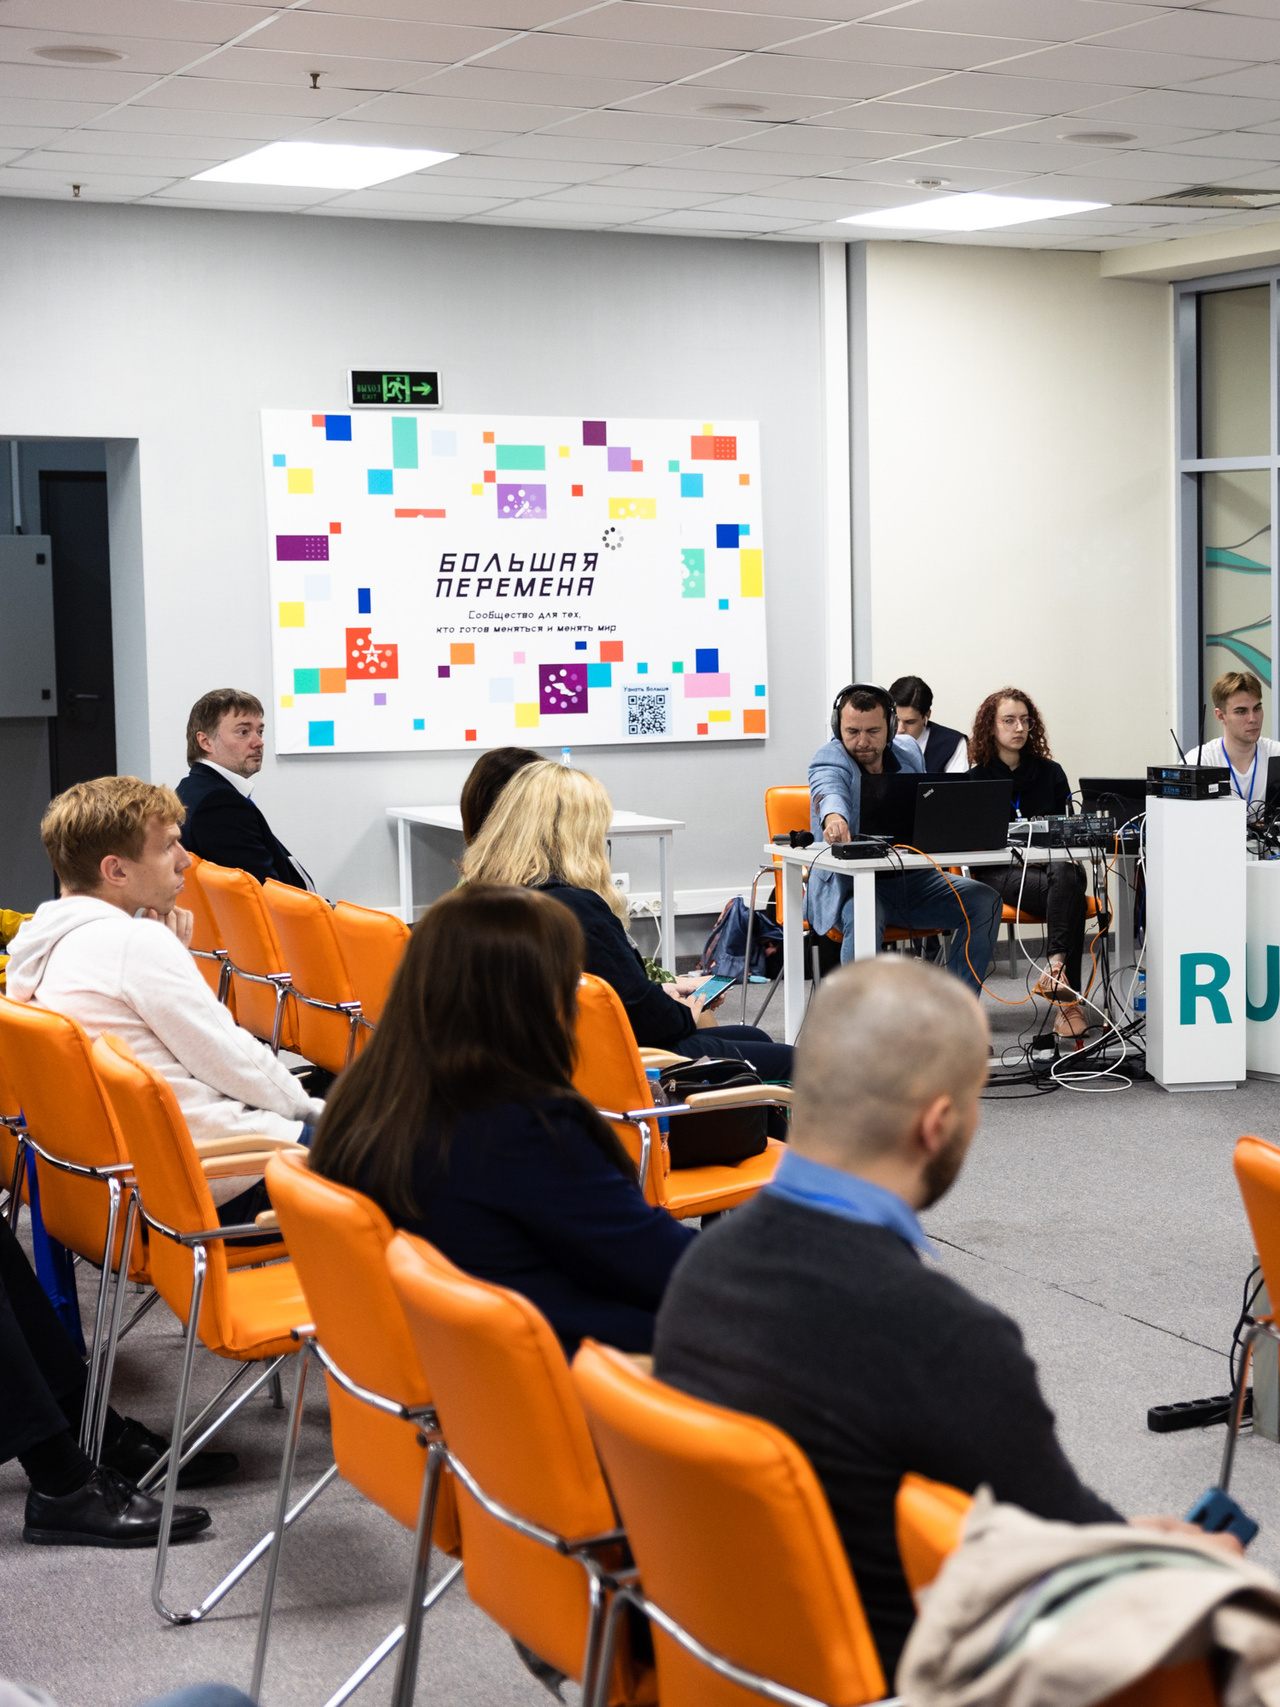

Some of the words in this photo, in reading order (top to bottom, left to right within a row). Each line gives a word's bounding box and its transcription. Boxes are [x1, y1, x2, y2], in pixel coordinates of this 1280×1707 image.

[439, 552, 599, 573] БОЛЬШАЯ
[435, 577, 595, 598] ПЕРЕМЕНА
[468, 610, 534, 621] Сообщество
[538, 611, 558, 620] для
[562, 611, 581, 620] тех,
[436, 626, 455, 634] кто
[493, 625, 543, 633] меняться
[597, 624, 617, 634] мир
